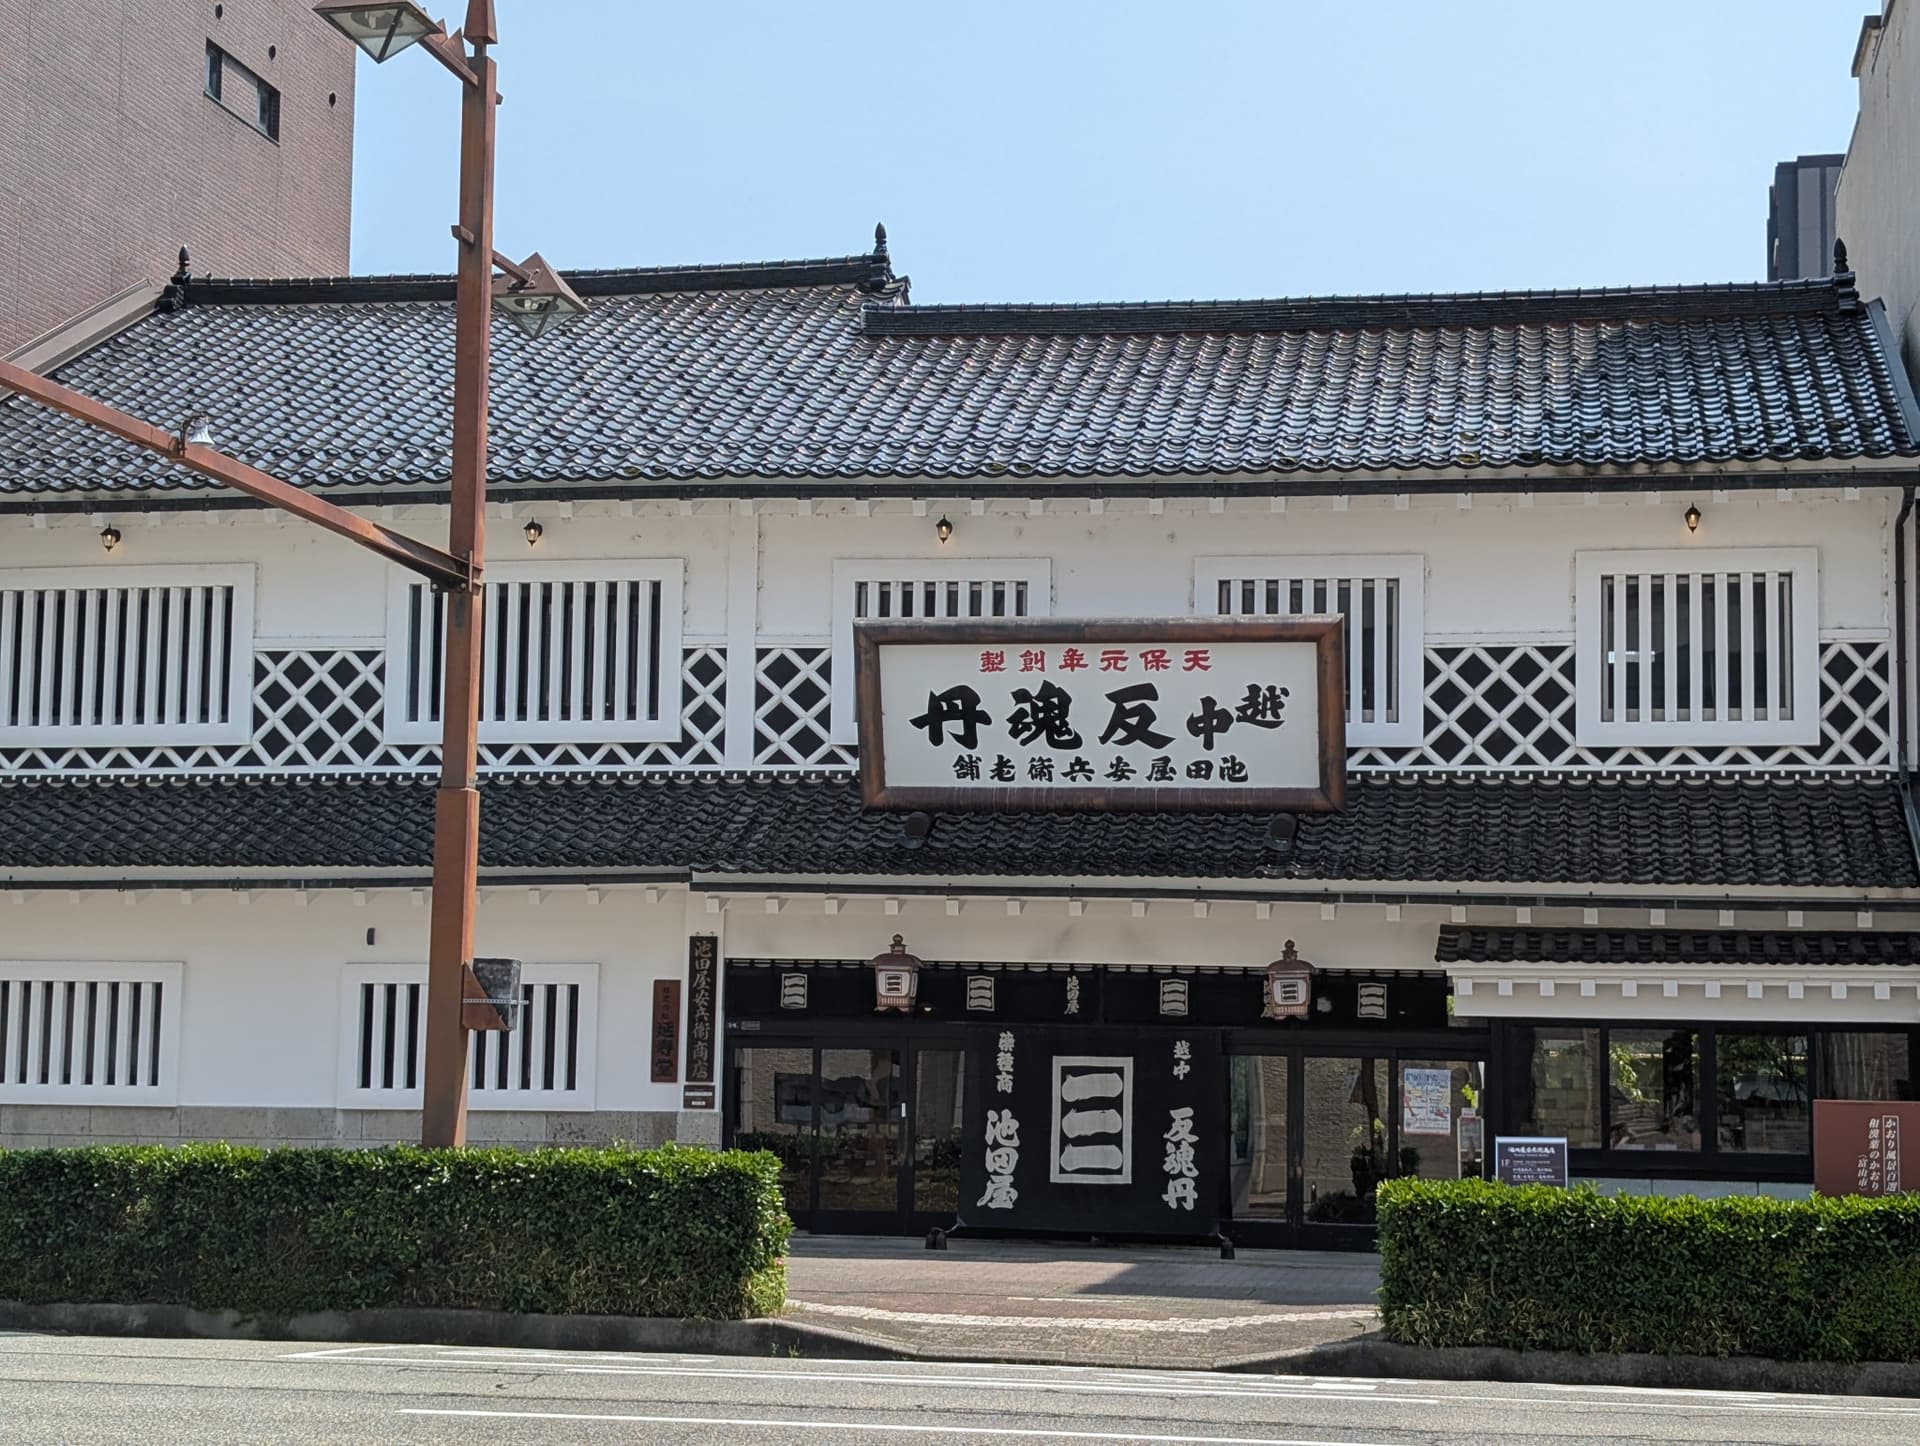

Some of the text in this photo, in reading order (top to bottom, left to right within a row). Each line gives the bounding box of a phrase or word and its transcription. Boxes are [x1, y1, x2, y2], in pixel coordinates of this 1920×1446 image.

[692, 941, 713, 1079] 池田屋安兵衛商店
[1064, 975, 1080, 1014] 池田屋
[977, 1108, 1020, 1209] 池田屋
[1162, 1040, 1199, 1210] 越中 反魂丹
